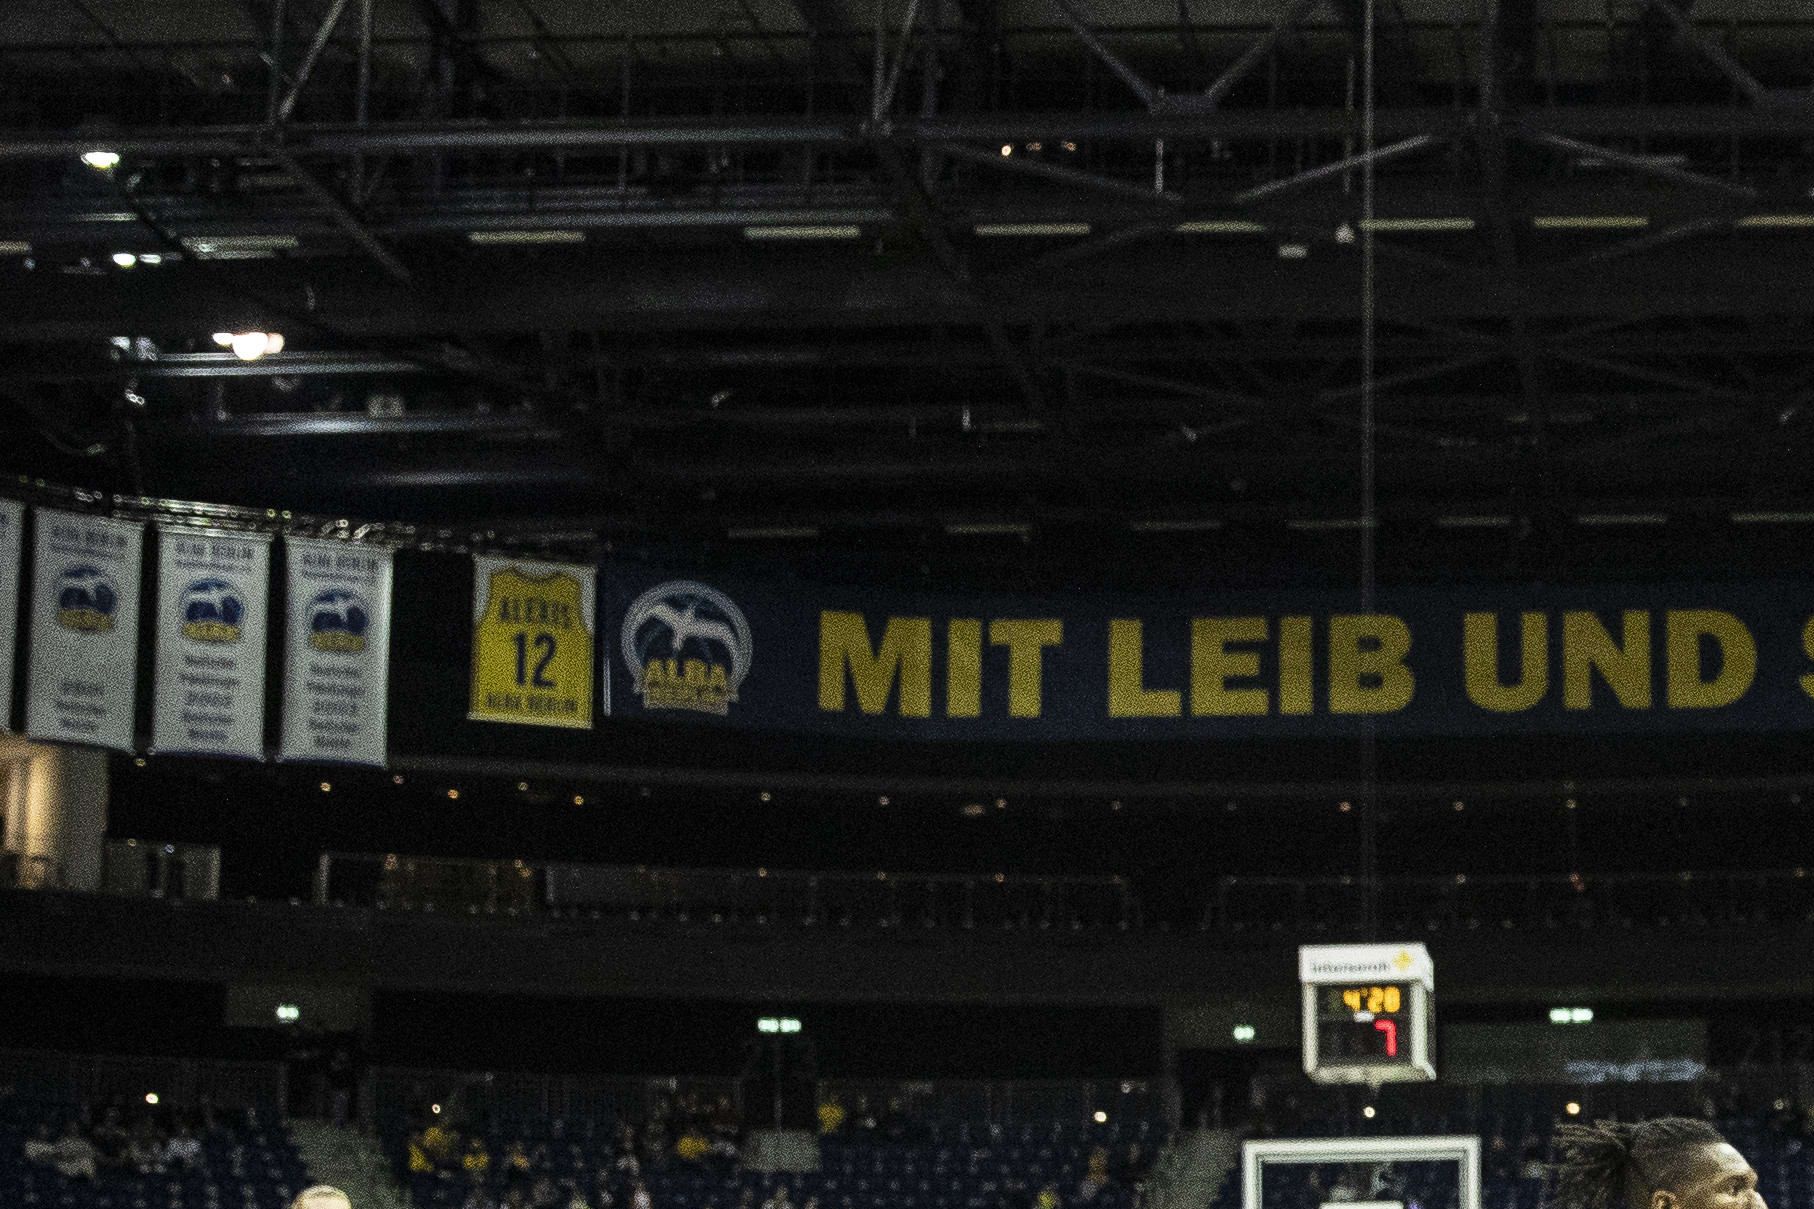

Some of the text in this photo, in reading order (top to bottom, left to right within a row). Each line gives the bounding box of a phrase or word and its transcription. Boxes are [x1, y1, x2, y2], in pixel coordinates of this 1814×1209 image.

[512, 632, 557, 689] 12
[645, 658, 728, 686] ALBA
[818, 610, 1063, 718] MIT
[1109, 614, 1416, 718] LEIB
[1463, 610, 1758, 713] UND
[1374, 1019, 1397, 1056] 7
